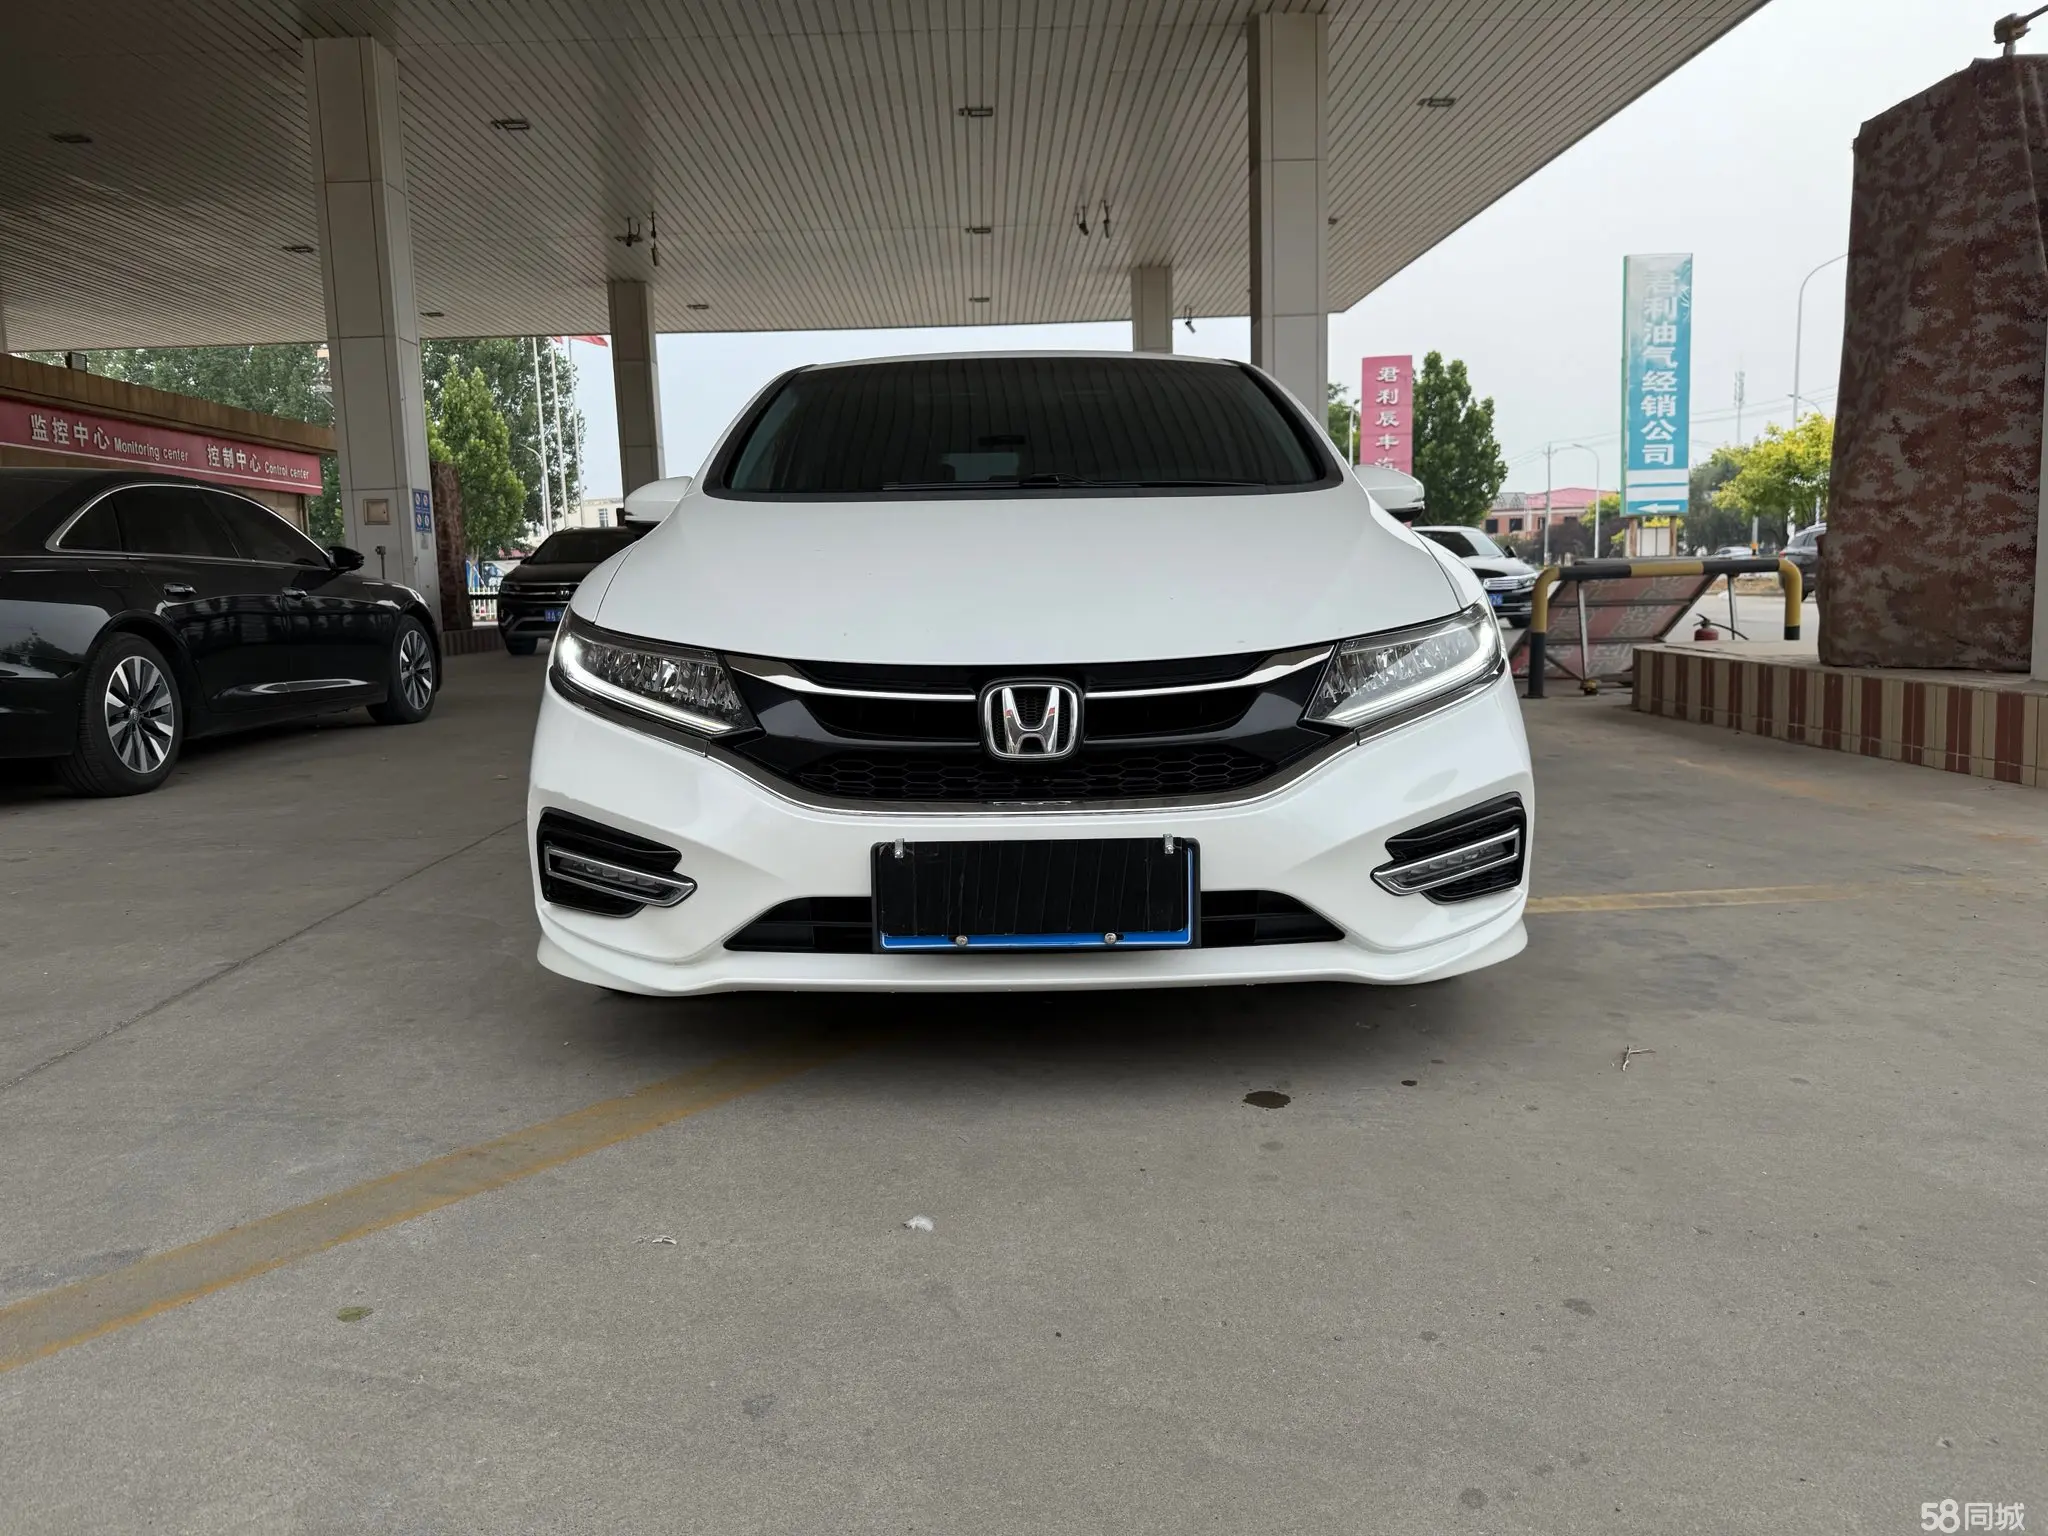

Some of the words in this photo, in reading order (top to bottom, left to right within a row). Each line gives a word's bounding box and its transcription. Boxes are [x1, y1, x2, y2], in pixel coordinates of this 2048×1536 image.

[1641, 269, 1679, 466] 君利油气经销公司
[31, 413, 110, 450] 监控中心
[114, 437, 160, 461] Monitoring
[162, 447, 189, 462] center
[207, 443, 261, 473] 控制中心
[264, 461, 288, 476] Control
[290, 467, 309, 480] center
